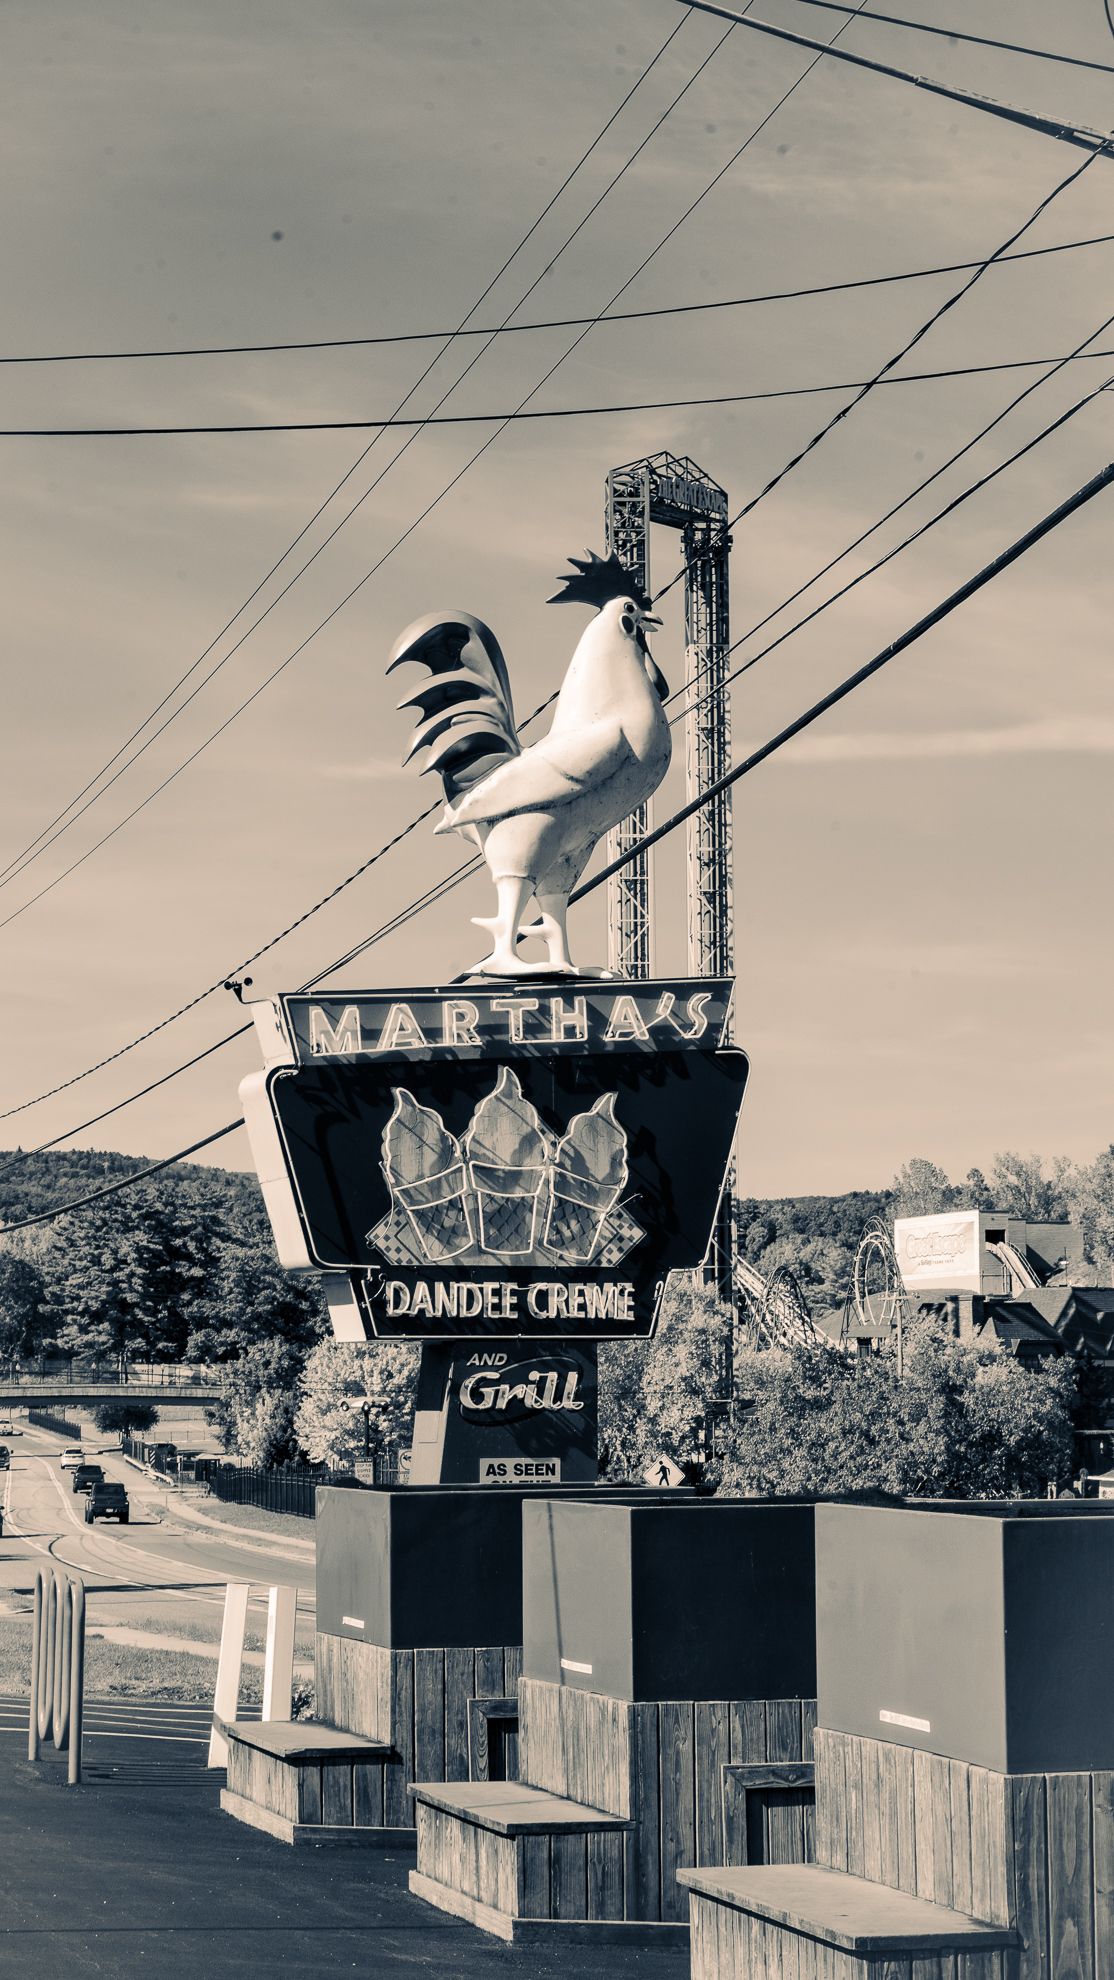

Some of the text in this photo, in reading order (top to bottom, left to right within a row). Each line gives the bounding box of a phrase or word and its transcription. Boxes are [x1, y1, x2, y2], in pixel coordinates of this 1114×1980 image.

[309, 991, 714, 1056] MARTHA'S
[386, 1281, 635, 1320] DANDEE CREME
[467, 1353, 507, 1366] AND
[459, 1371, 584, 1411] Grill
[486, 1463, 556, 1476] AS SEEN
